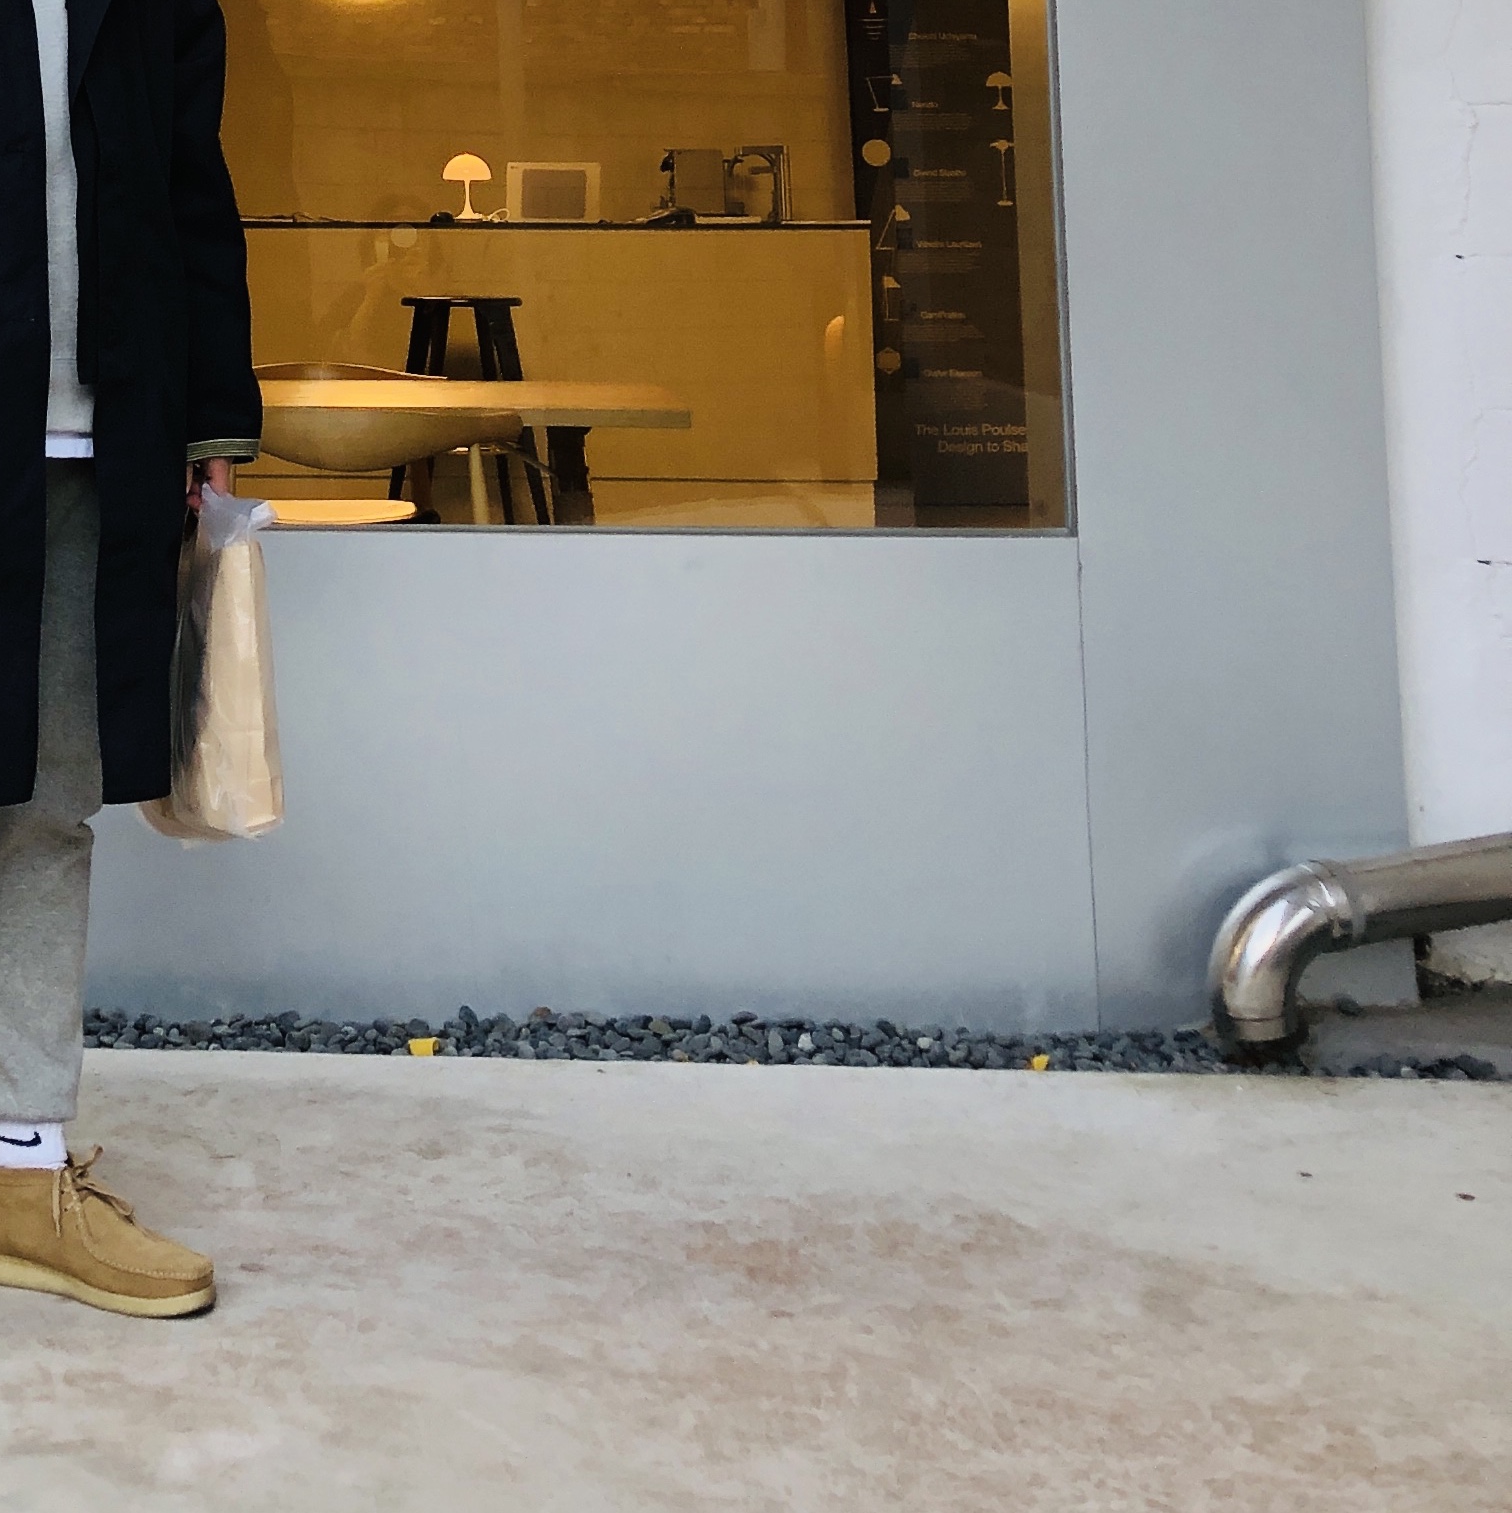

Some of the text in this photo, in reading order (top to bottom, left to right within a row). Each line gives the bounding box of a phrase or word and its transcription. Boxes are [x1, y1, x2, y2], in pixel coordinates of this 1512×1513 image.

[916, 424, 939, 436] The
[943, 423, 978, 436] Louis
[938, 440, 983, 455] Design
[987, 441, 1000, 452] to
